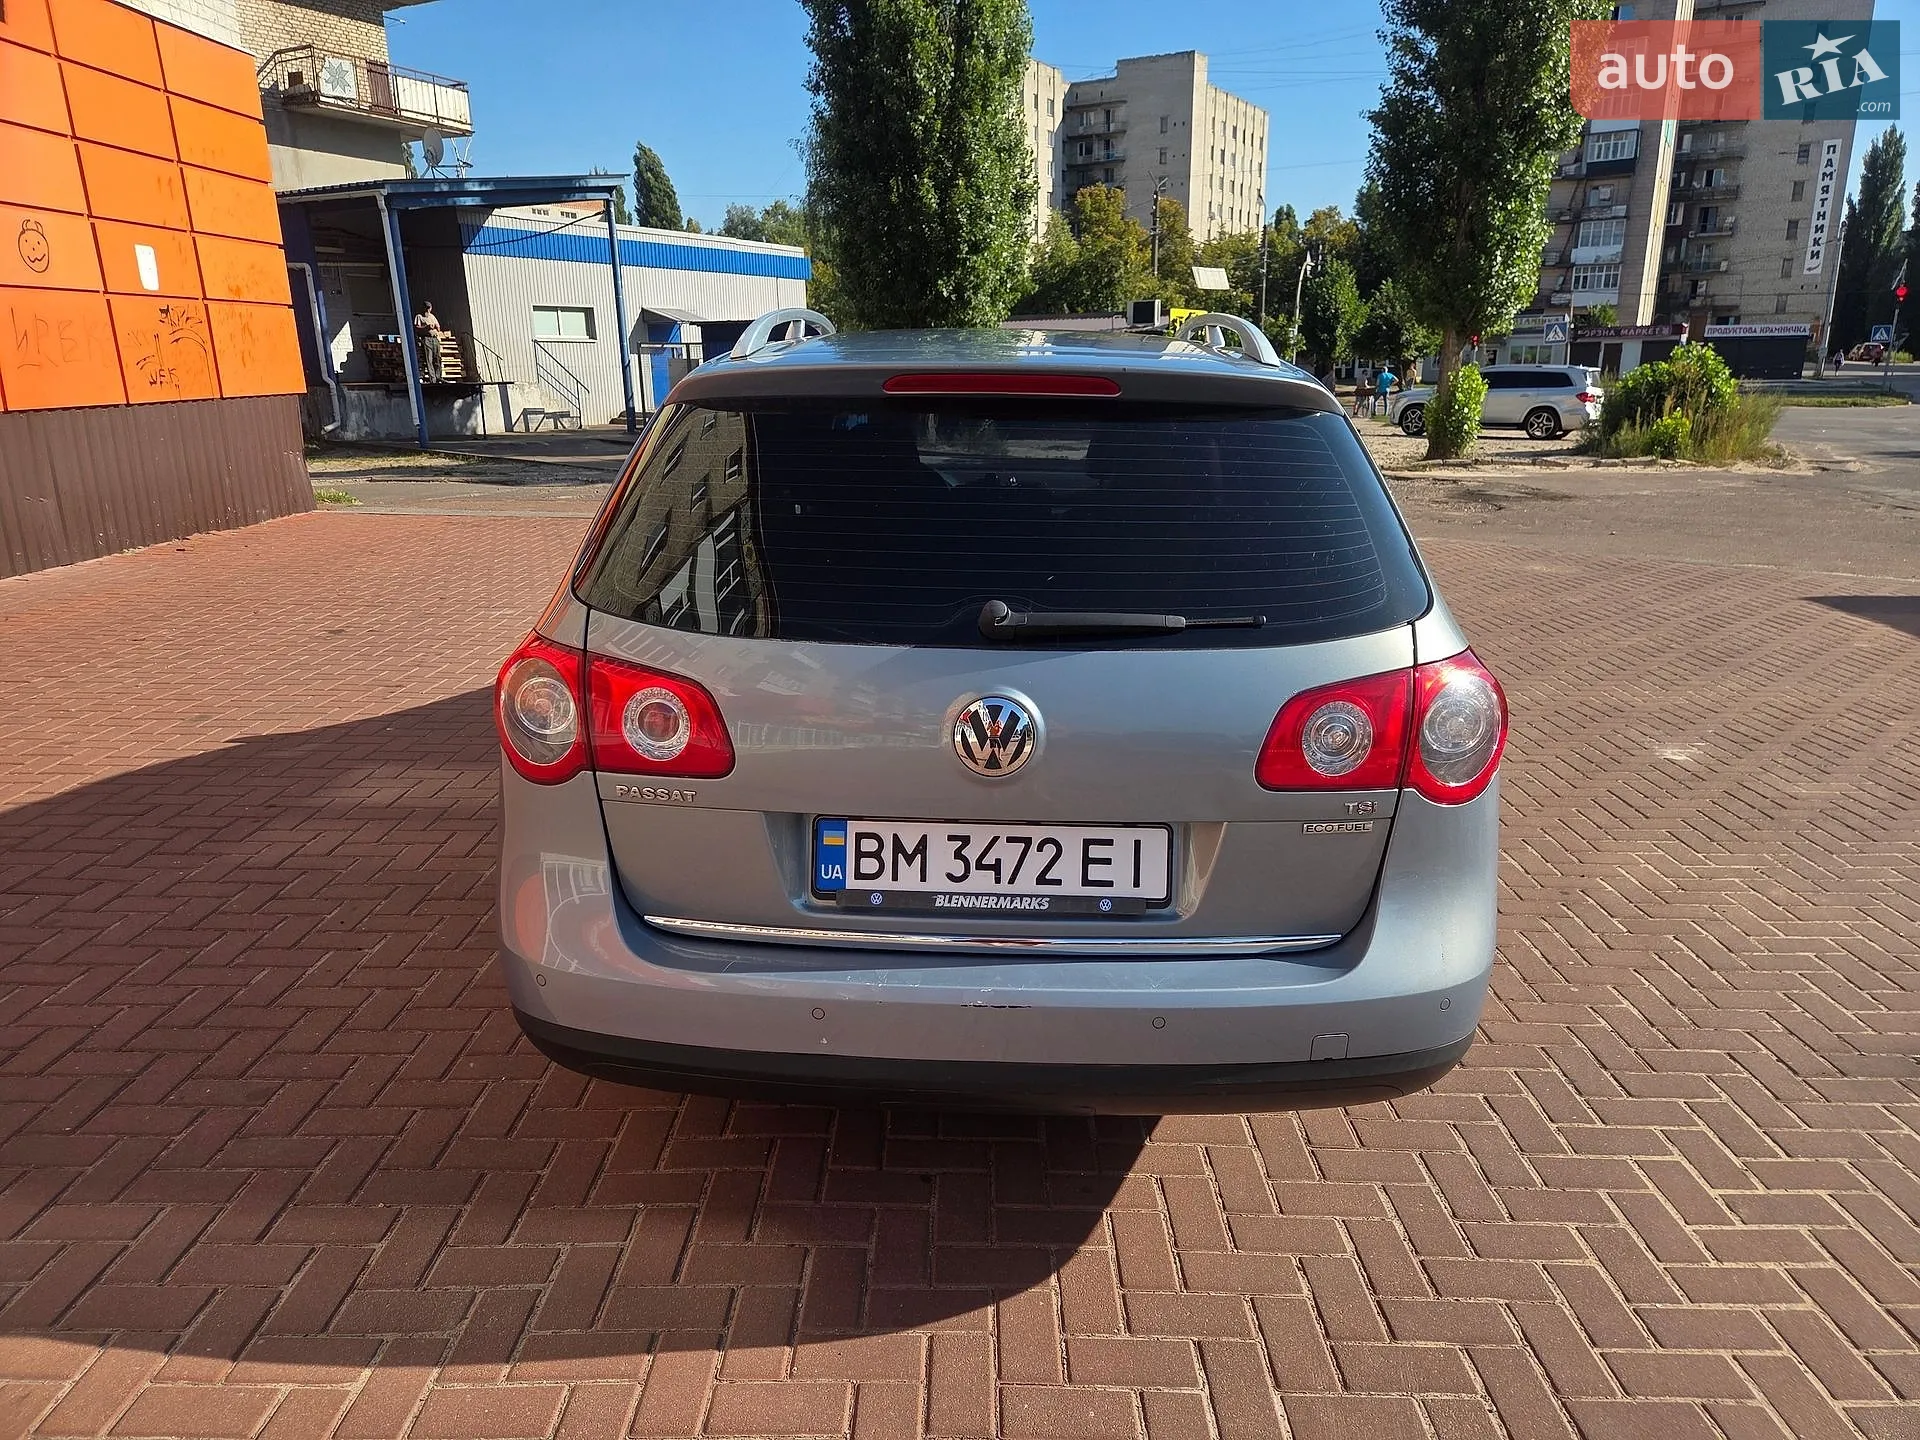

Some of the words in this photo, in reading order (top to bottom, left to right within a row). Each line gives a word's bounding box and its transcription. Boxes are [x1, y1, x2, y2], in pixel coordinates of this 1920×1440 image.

[1706, 327, 1757, 335] ПРОДУКТОВА
[1760, 325, 1807, 334] КРАМНИЧКА
[615, 784, 697, 802] PASSAT
[853, 832, 928, 882] BM
[944, 834, 1063, 887] 3472
[821, 864, 843, 880] UA
[932, 894, 1050, 910] BLENNERMARKS
